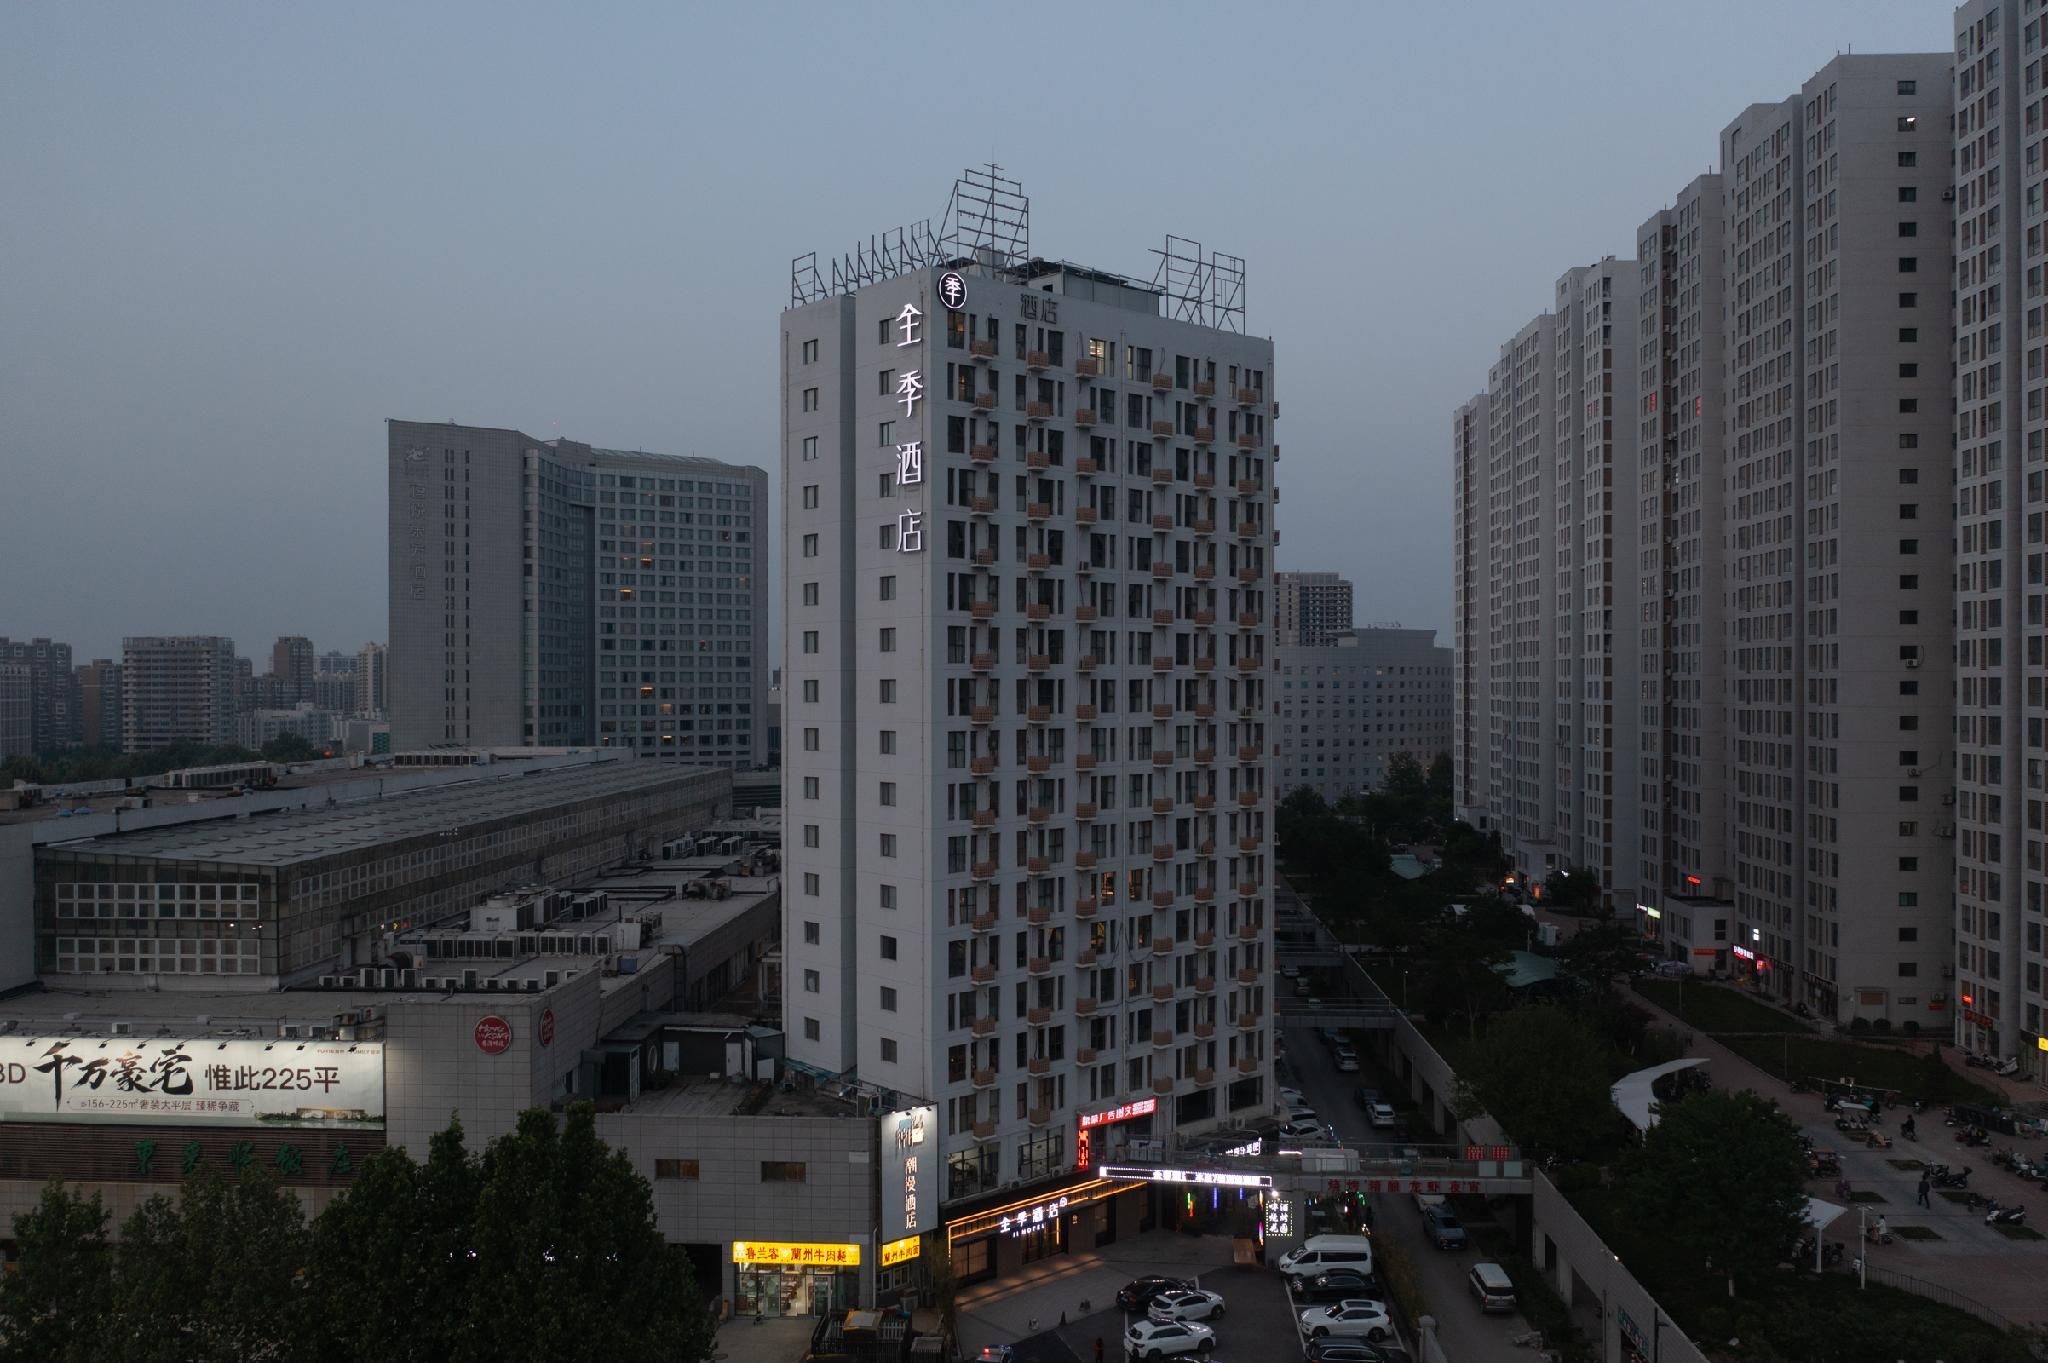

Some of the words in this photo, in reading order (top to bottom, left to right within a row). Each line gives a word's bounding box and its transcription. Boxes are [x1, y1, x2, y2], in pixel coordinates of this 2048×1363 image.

[943, 276, 963, 306] 季
[1020, 293, 1058, 325] 酒店
[895, 302, 925, 553] 全季酒店
[32, 1041, 194, 1112] 千万豪宅
[905, 1156, 918, 1230] 潮漫酒店
[1000, 1202, 1058, 1234] 全季酒店
